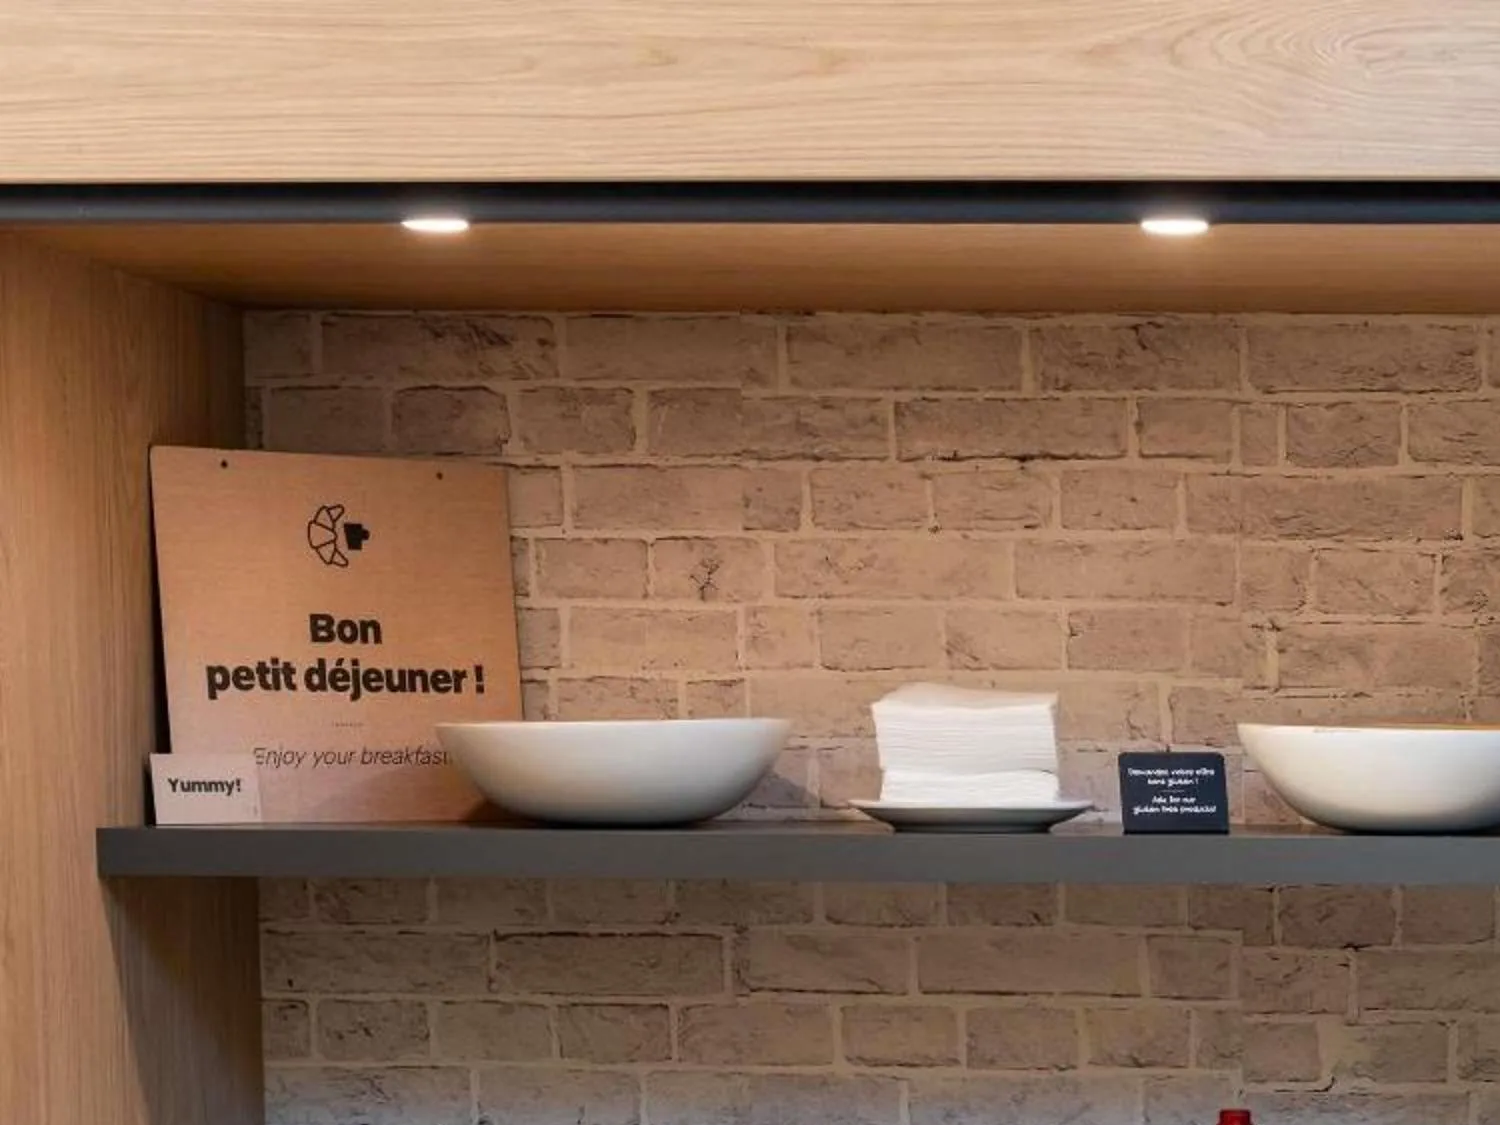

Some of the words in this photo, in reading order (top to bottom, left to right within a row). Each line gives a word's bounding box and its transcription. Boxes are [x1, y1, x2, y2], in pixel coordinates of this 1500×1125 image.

[309, 613, 382, 644] Bon
[206, 656, 297, 700] petit
[304, 658, 467, 701] déjeuner
[474, 664, 485, 693] !
[254, 747, 307, 768] Enjoy
[312, 750, 354, 768] your
[167, 778, 241, 796] Yummy!
